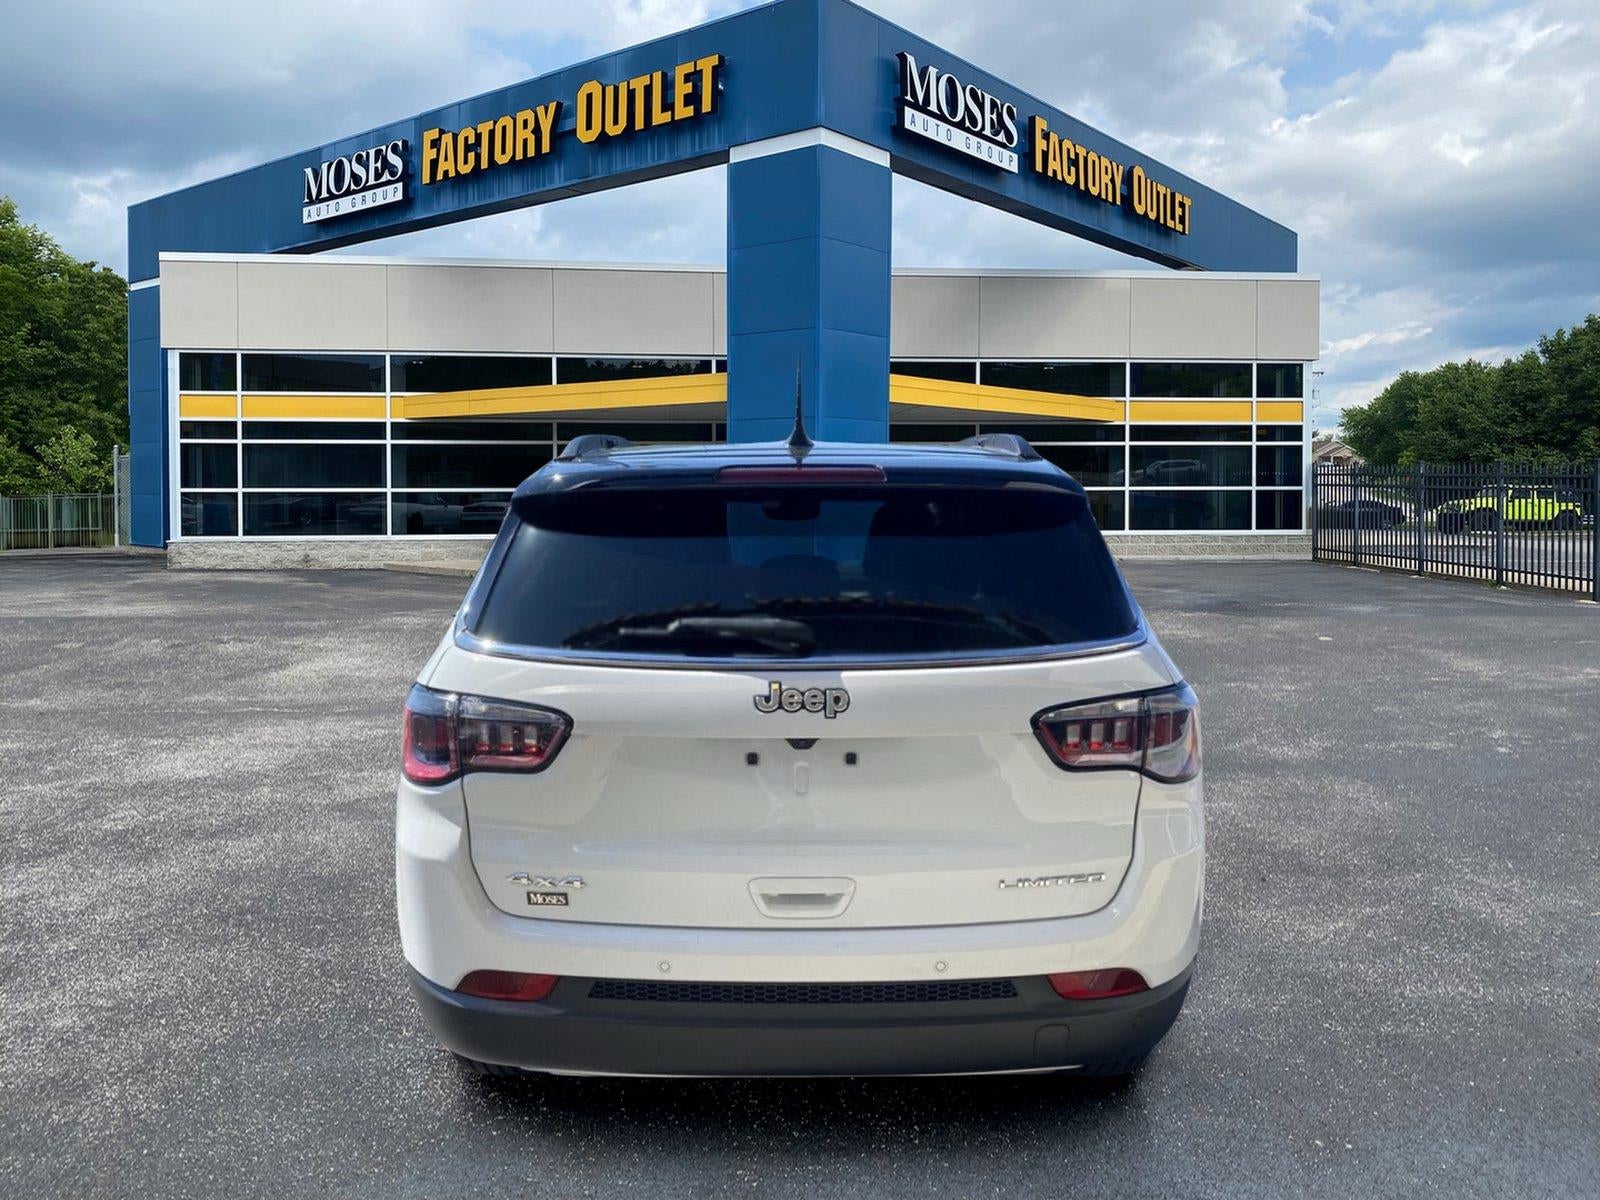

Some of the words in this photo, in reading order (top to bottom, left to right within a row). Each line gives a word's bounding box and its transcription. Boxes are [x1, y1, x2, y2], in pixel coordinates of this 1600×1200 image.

[422, 100, 560, 185] FACTORY
[575, 54, 720, 144] OUTLET
[904, 52, 1018, 148] MOSES
[909, 112, 953, 142] AUTO
[965, 128, 1014, 167] GROUP
[303, 139, 403, 203] MOSES
[1033, 114, 1124, 206] FACTORY
[1132, 164, 1192, 235] OUTLET
[306, 201, 340, 219] AUTO
[350, 186, 399, 208] GROUP
[753, 680, 851, 719] Jeep
[529, 892, 567, 905] MOSES
[999, 872, 1105, 889] LIMITED
